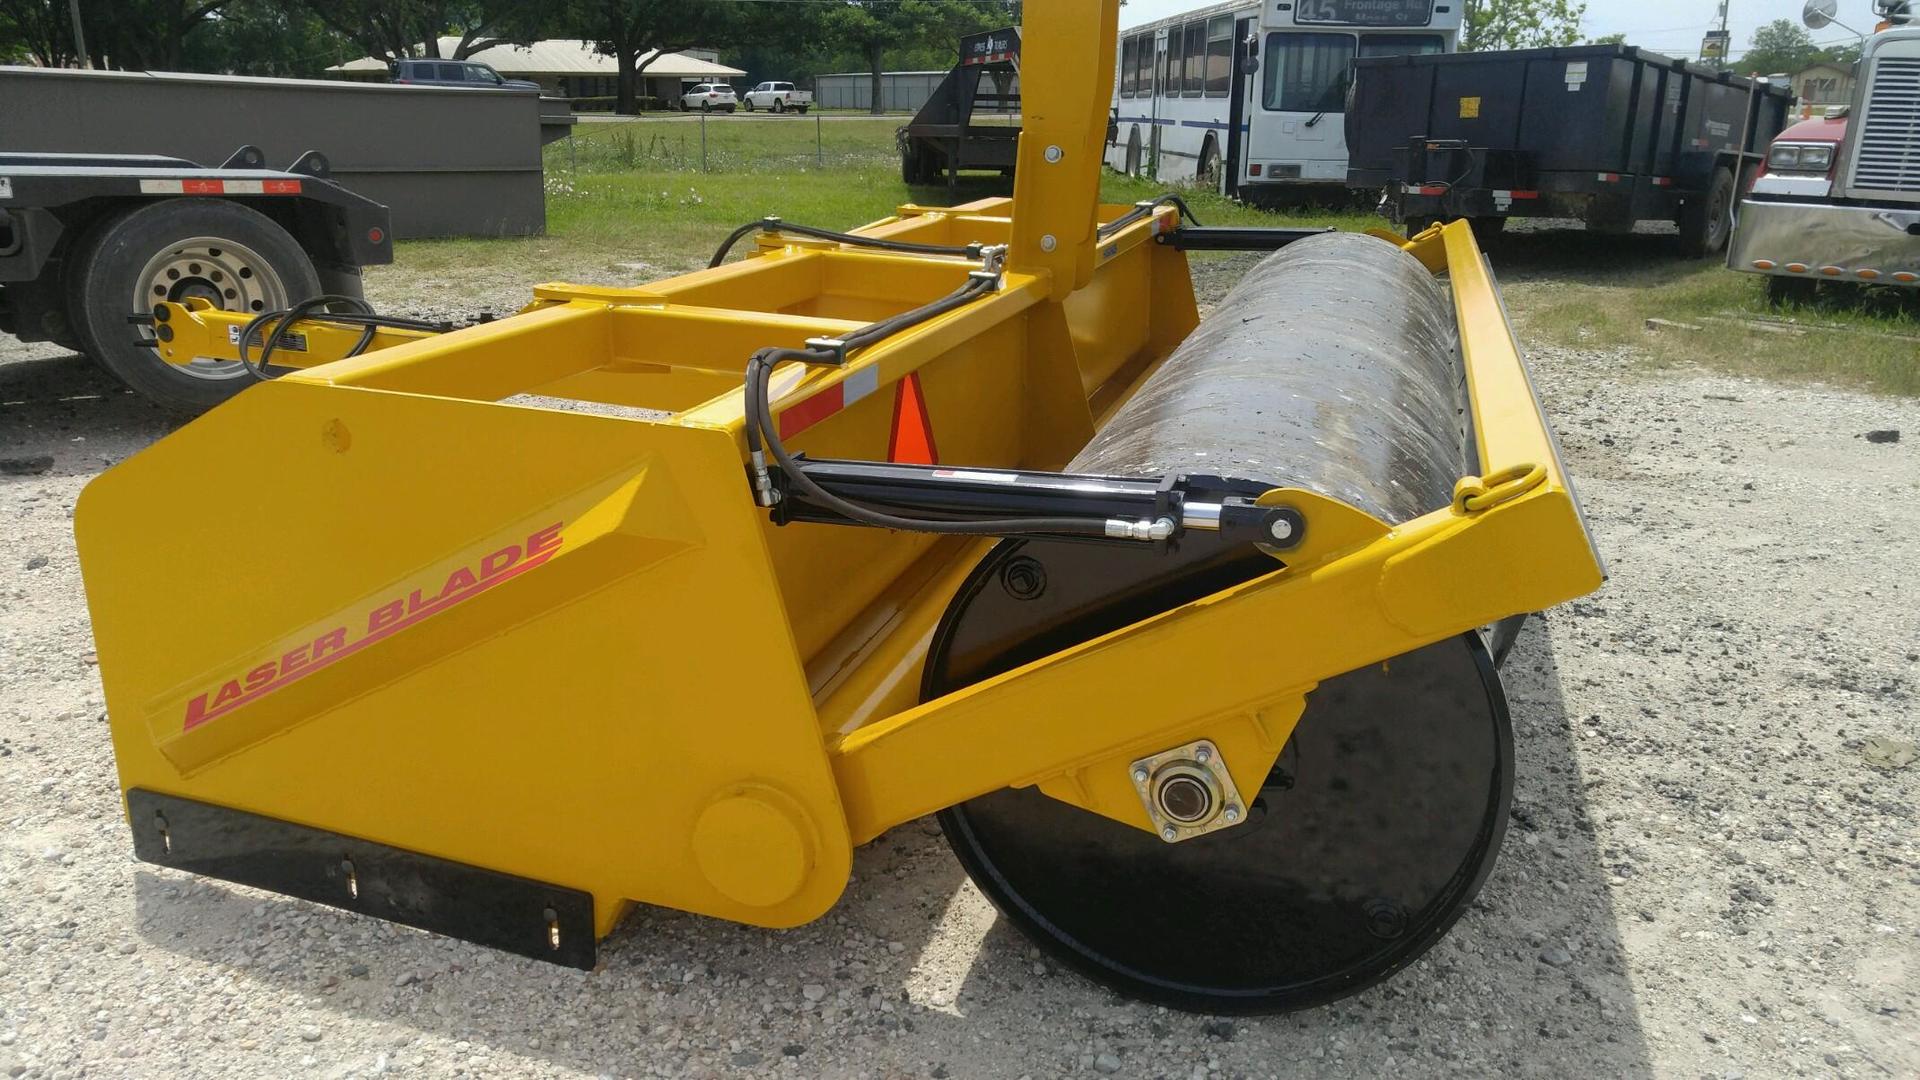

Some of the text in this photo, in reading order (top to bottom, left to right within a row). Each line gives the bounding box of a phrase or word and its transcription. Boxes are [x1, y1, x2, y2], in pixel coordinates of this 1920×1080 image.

[1300, 0, 1336, 19] 45
[184, 521, 563, 733] LASER BLADE
